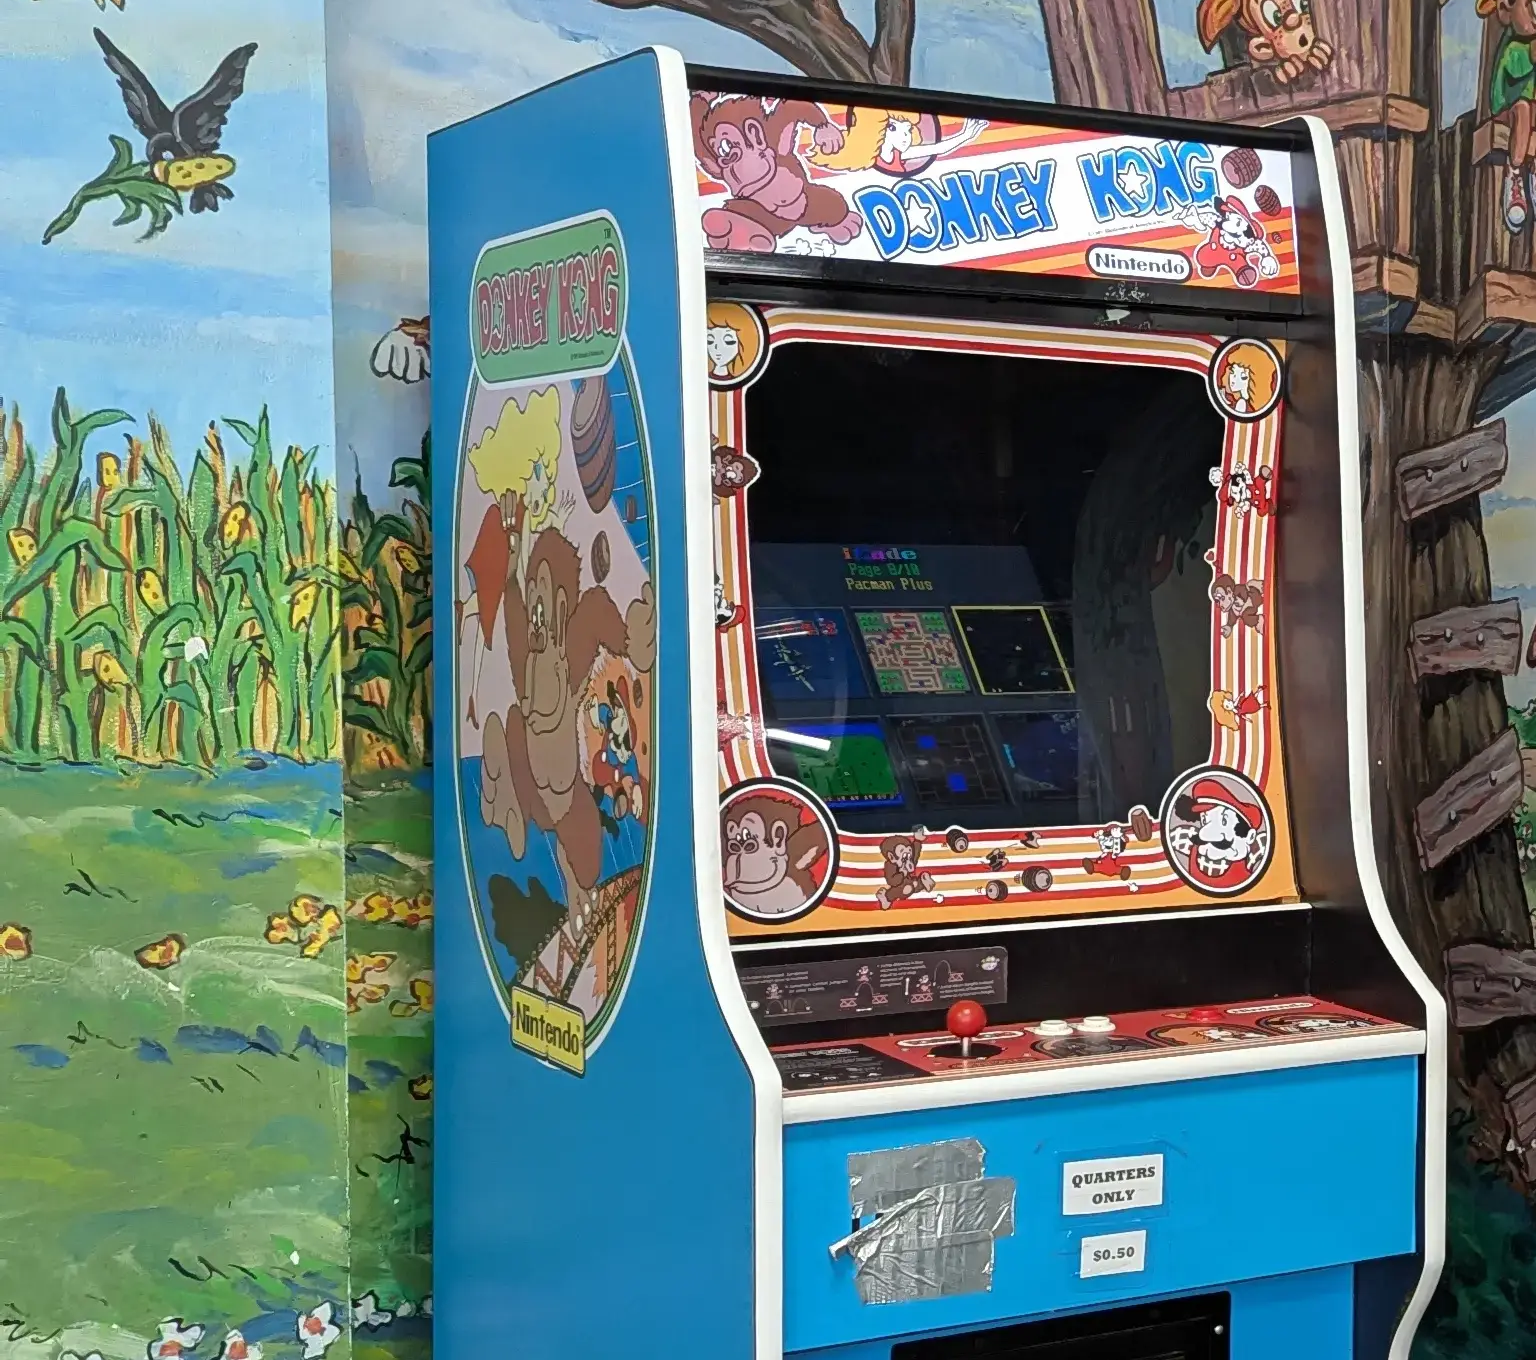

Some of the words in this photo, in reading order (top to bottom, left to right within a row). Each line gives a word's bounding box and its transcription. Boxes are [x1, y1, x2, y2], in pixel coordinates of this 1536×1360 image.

[852, 158, 1058, 260] DONKEY
[1076, 139, 1220, 224] KONG
[1095, 252, 1185, 275] Nintendo
[476, 260, 554, 359] DONKEY
[556, 243, 620, 344] KONG
[848, 563, 882, 577] Page
[845, 578, 895, 590] Pacman
[900, 578, 933, 591] Plus
[515, 1001, 580, 1055] Nintendo
[1072, 1166, 1156, 1189] QUARTERS
[1092, 1189, 1135, 1205] ONLY
[1093, 1246, 1135, 1262] $0.50
